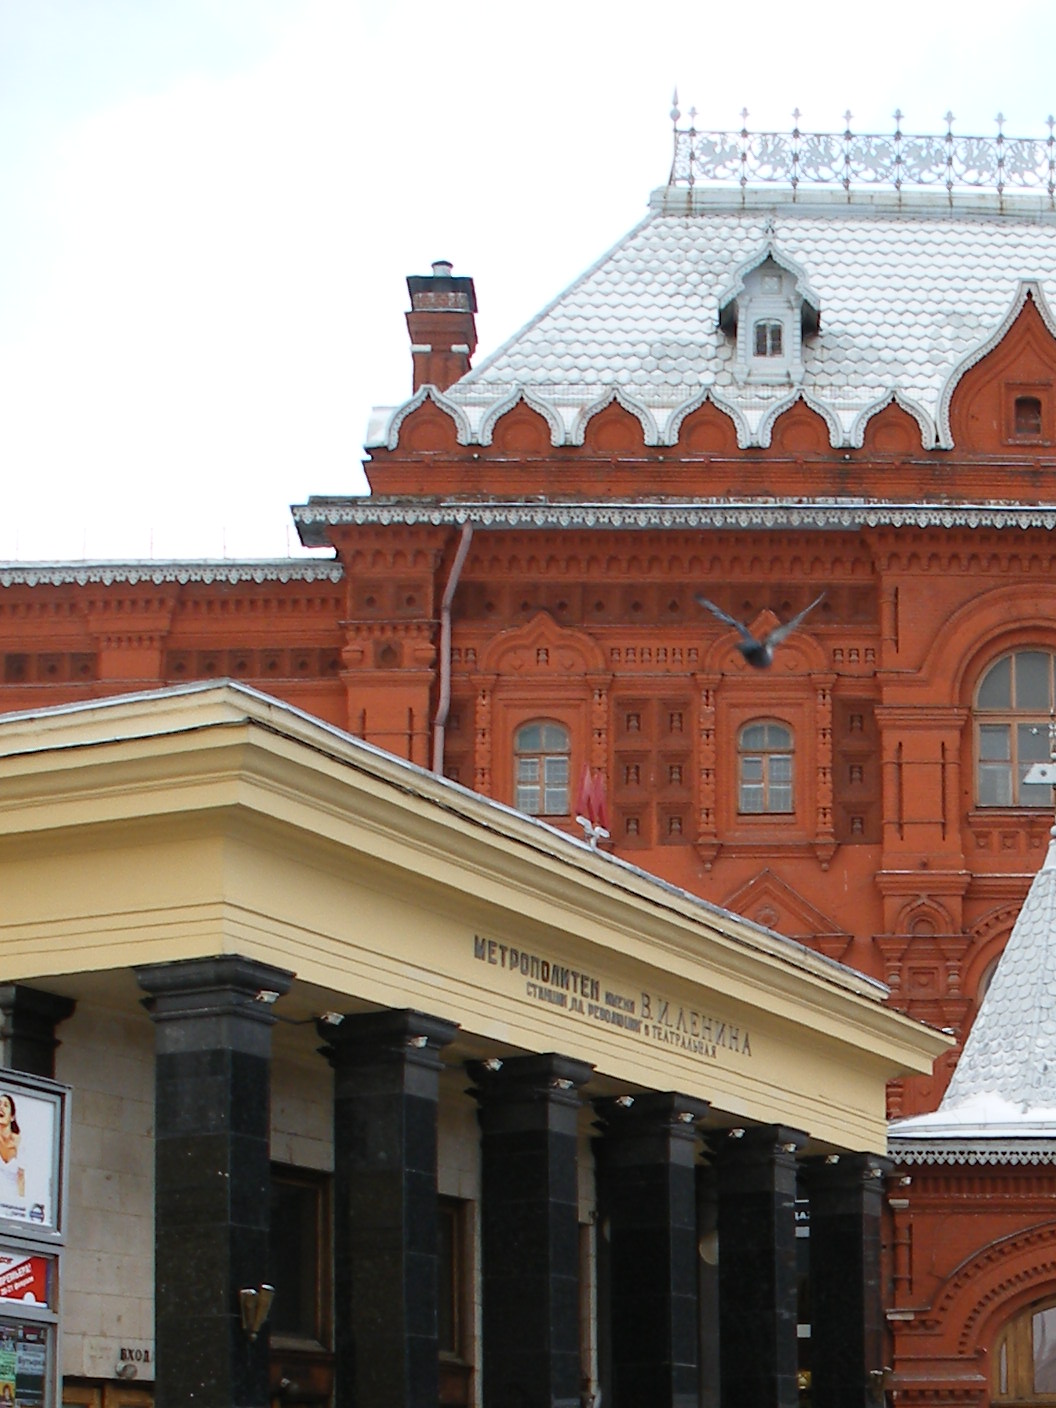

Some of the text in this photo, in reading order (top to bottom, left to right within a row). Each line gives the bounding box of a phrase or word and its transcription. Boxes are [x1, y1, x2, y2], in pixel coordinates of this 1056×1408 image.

[474, 934, 600, 1002] МЕТРОПОЛИТЕН
[651, 1025, 717, 1059] ТЕАТРАЛЬНАЯ
[120, 1347, 150, 1363] ВХОД
